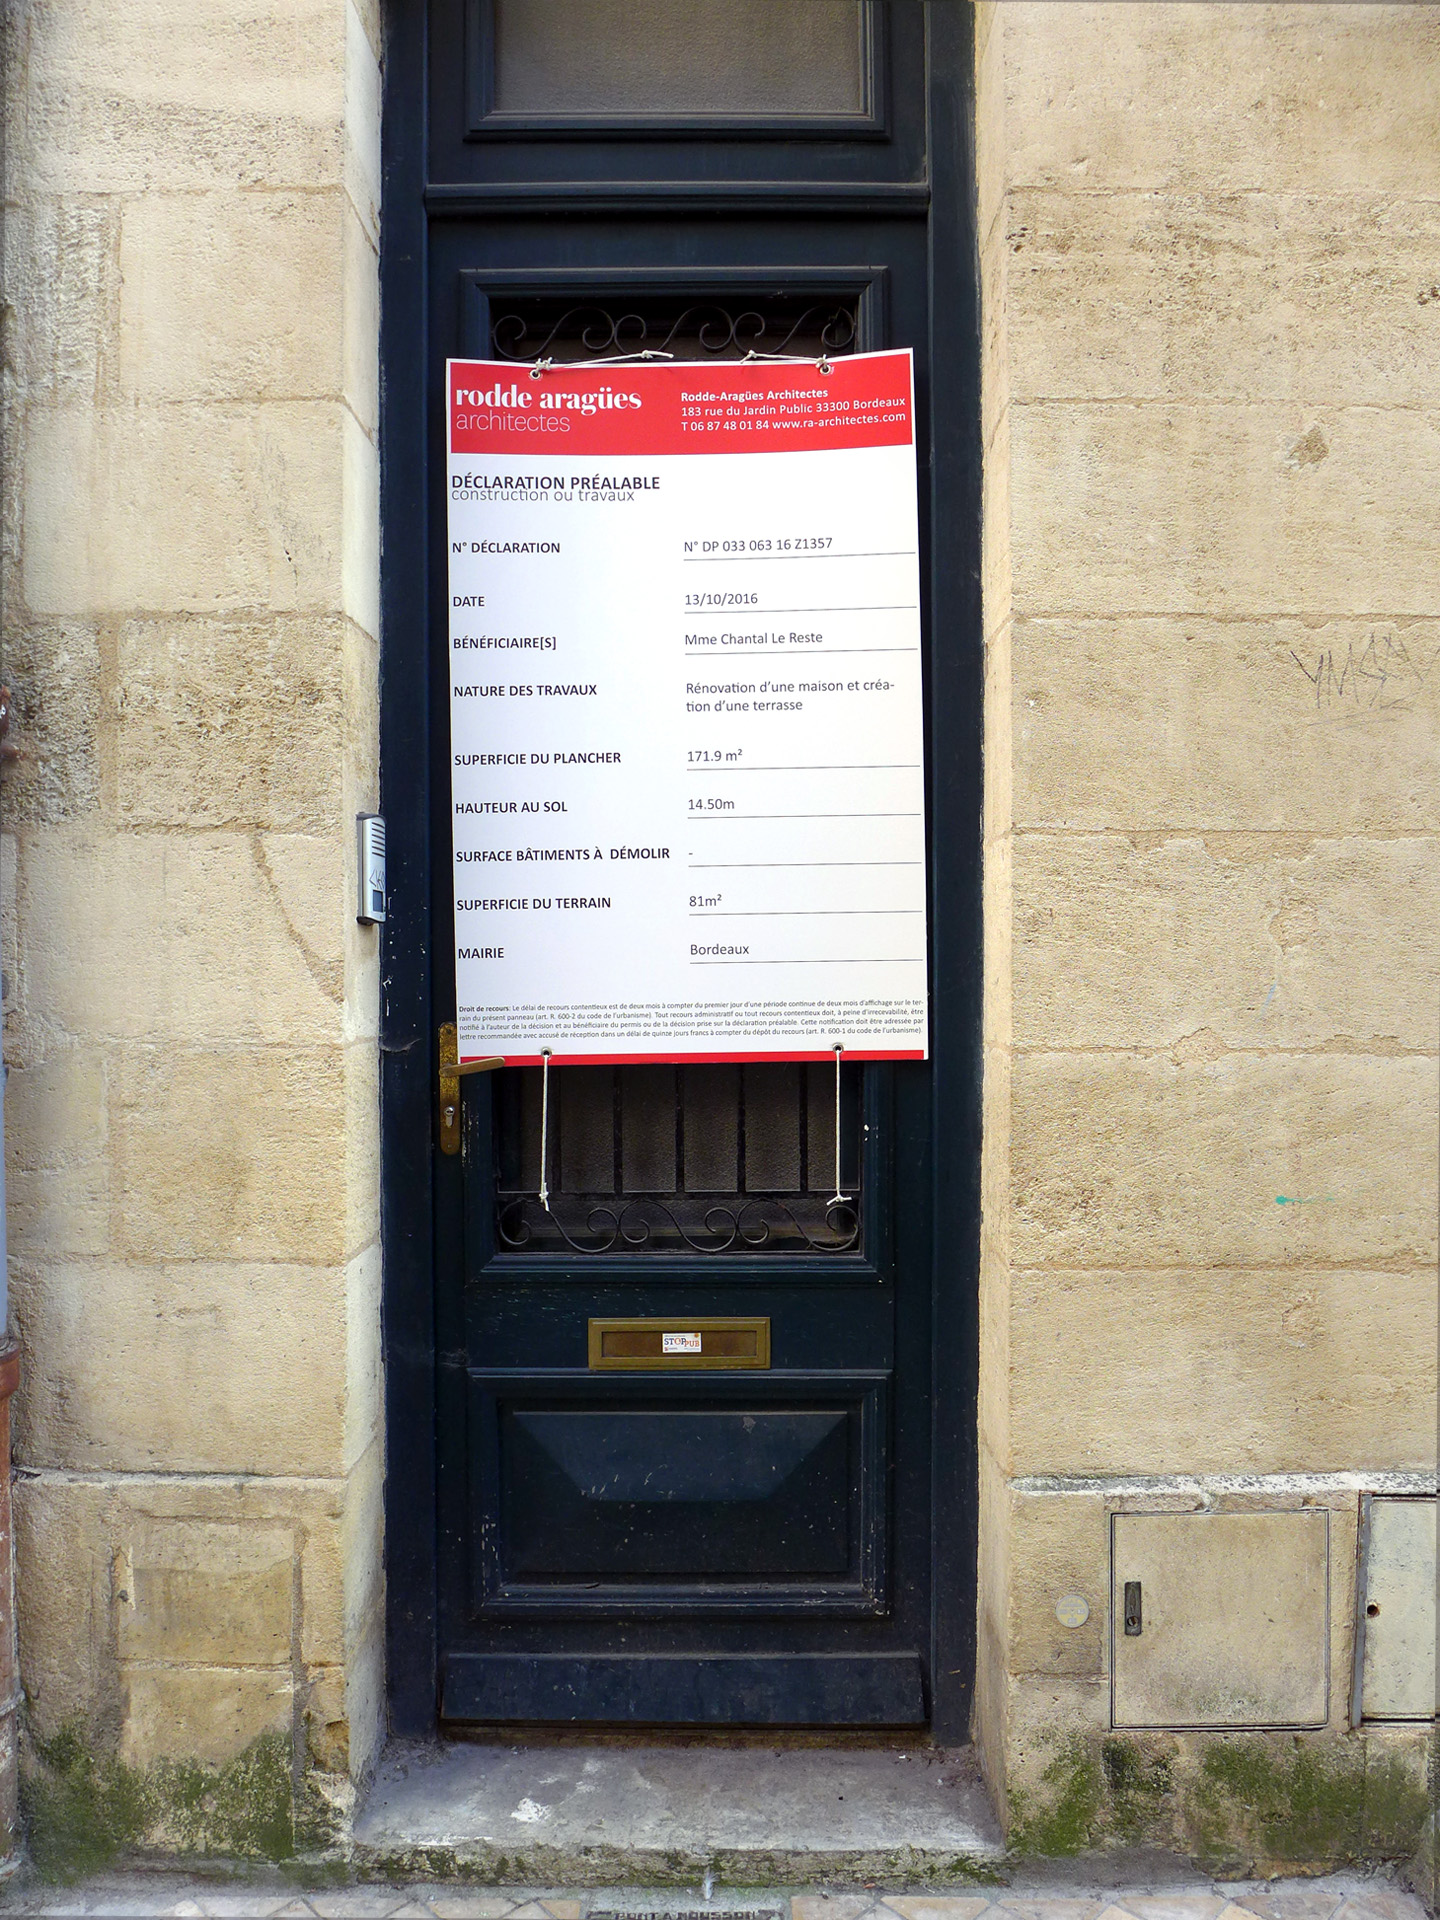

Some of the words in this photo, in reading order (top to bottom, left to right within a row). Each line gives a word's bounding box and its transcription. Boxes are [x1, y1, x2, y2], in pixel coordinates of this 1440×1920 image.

[456, 383, 532, 412] rodde
[539, 385, 641, 416] aragües
[681, 390, 763, 404] Rodde-Aragües
[766, 388, 828, 399] Architectes
[682, 406, 701, 416] 183
[705, 408, 722, 416] rue
[726, 405, 739, 415] du
[743, 404, 775, 415] Jardin
[780, 403, 812, 414] Public
[816, 400, 849, 412] 33300
[853, 396, 905, 409] Bordeaux
[456, 411, 570, 432] architectes
[681, 421, 687, 430] T
[690, 421, 704, 431] 06
[707, 421, 720, 430] 87
[723, 420, 736, 430] 48
[739, 420, 752, 430] 01
[756, 419, 769, 429] 84
[772, 413, 905, 429] www.ra-architectes.com
[452, 472, 564, 490] DÉCLARATION
[571, 473, 659, 489] PRÉALABLE
[451, 489, 548, 501] construction
[553, 491, 572, 501] ou
[578, 489, 634, 501] travaux
[471, 539, 559, 553] DÉCLARATION
[702, 541, 719, 552] DP
[722, 540, 745, 551] 033
[749, 539, 772, 551] 063
[777, 539, 791, 550] 16
[795, 537, 832, 549] Z1357
[453, 596, 484, 606] DATE
[685, 592, 757, 606] 13/10/2016
[453, 635, 555, 650] BÉNÉFICIAIRE[S]
[685, 634, 717, 645] Mme
[720, 632, 767, 644] Chantal
[772, 633, 785, 643] Le
[789, 632, 822, 643] Reste
[454, 686, 504, 697] NATURE
[509, 685, 532, 696] DES
[536, 684, 596, 695] TRAVAUX
[686, 681, 755, 694] Rénovation
[759, 681, 794, 692] d'une
[798, 680, 843, 691] maison
[847, 681, 859, 690] et
[863, 678, 894, 690] créa-
[686, 701, 710, 712] tion
[714, 700, 749, 711] d'une
[753, 700, 802, 710] terrasse
[454, 753, 526, 765] SUPERFICIE
[530, 753, 548, 764] DU
[554, 752, 620, 763] PLANCHER
[688, 750, 721, 761] 171.9
[455, 802, 517, 813] HAUTEUR
[521, 802, 539, 812] AU
[543, 801, 567, 812] SOL
[688, 798, 734, 809] 14.50m
[456, 850, 512, 862] SURFACE
[516, 846, 589, 860] BÂTIMENTS
[593, 846, 602, 859] À
[610, 845, 669, 859] DÉMOLIR
[456, 897, 528, 912] SUPERFICIE
[532, 898, 551, 909] DU
[555, 897, 610, 908] TERRAIN
[458, 947, 504, 958] MAIRIE
[690, 943, 749, 955] Bordeaux
[859, 999, 892, 1007] d'affichage
